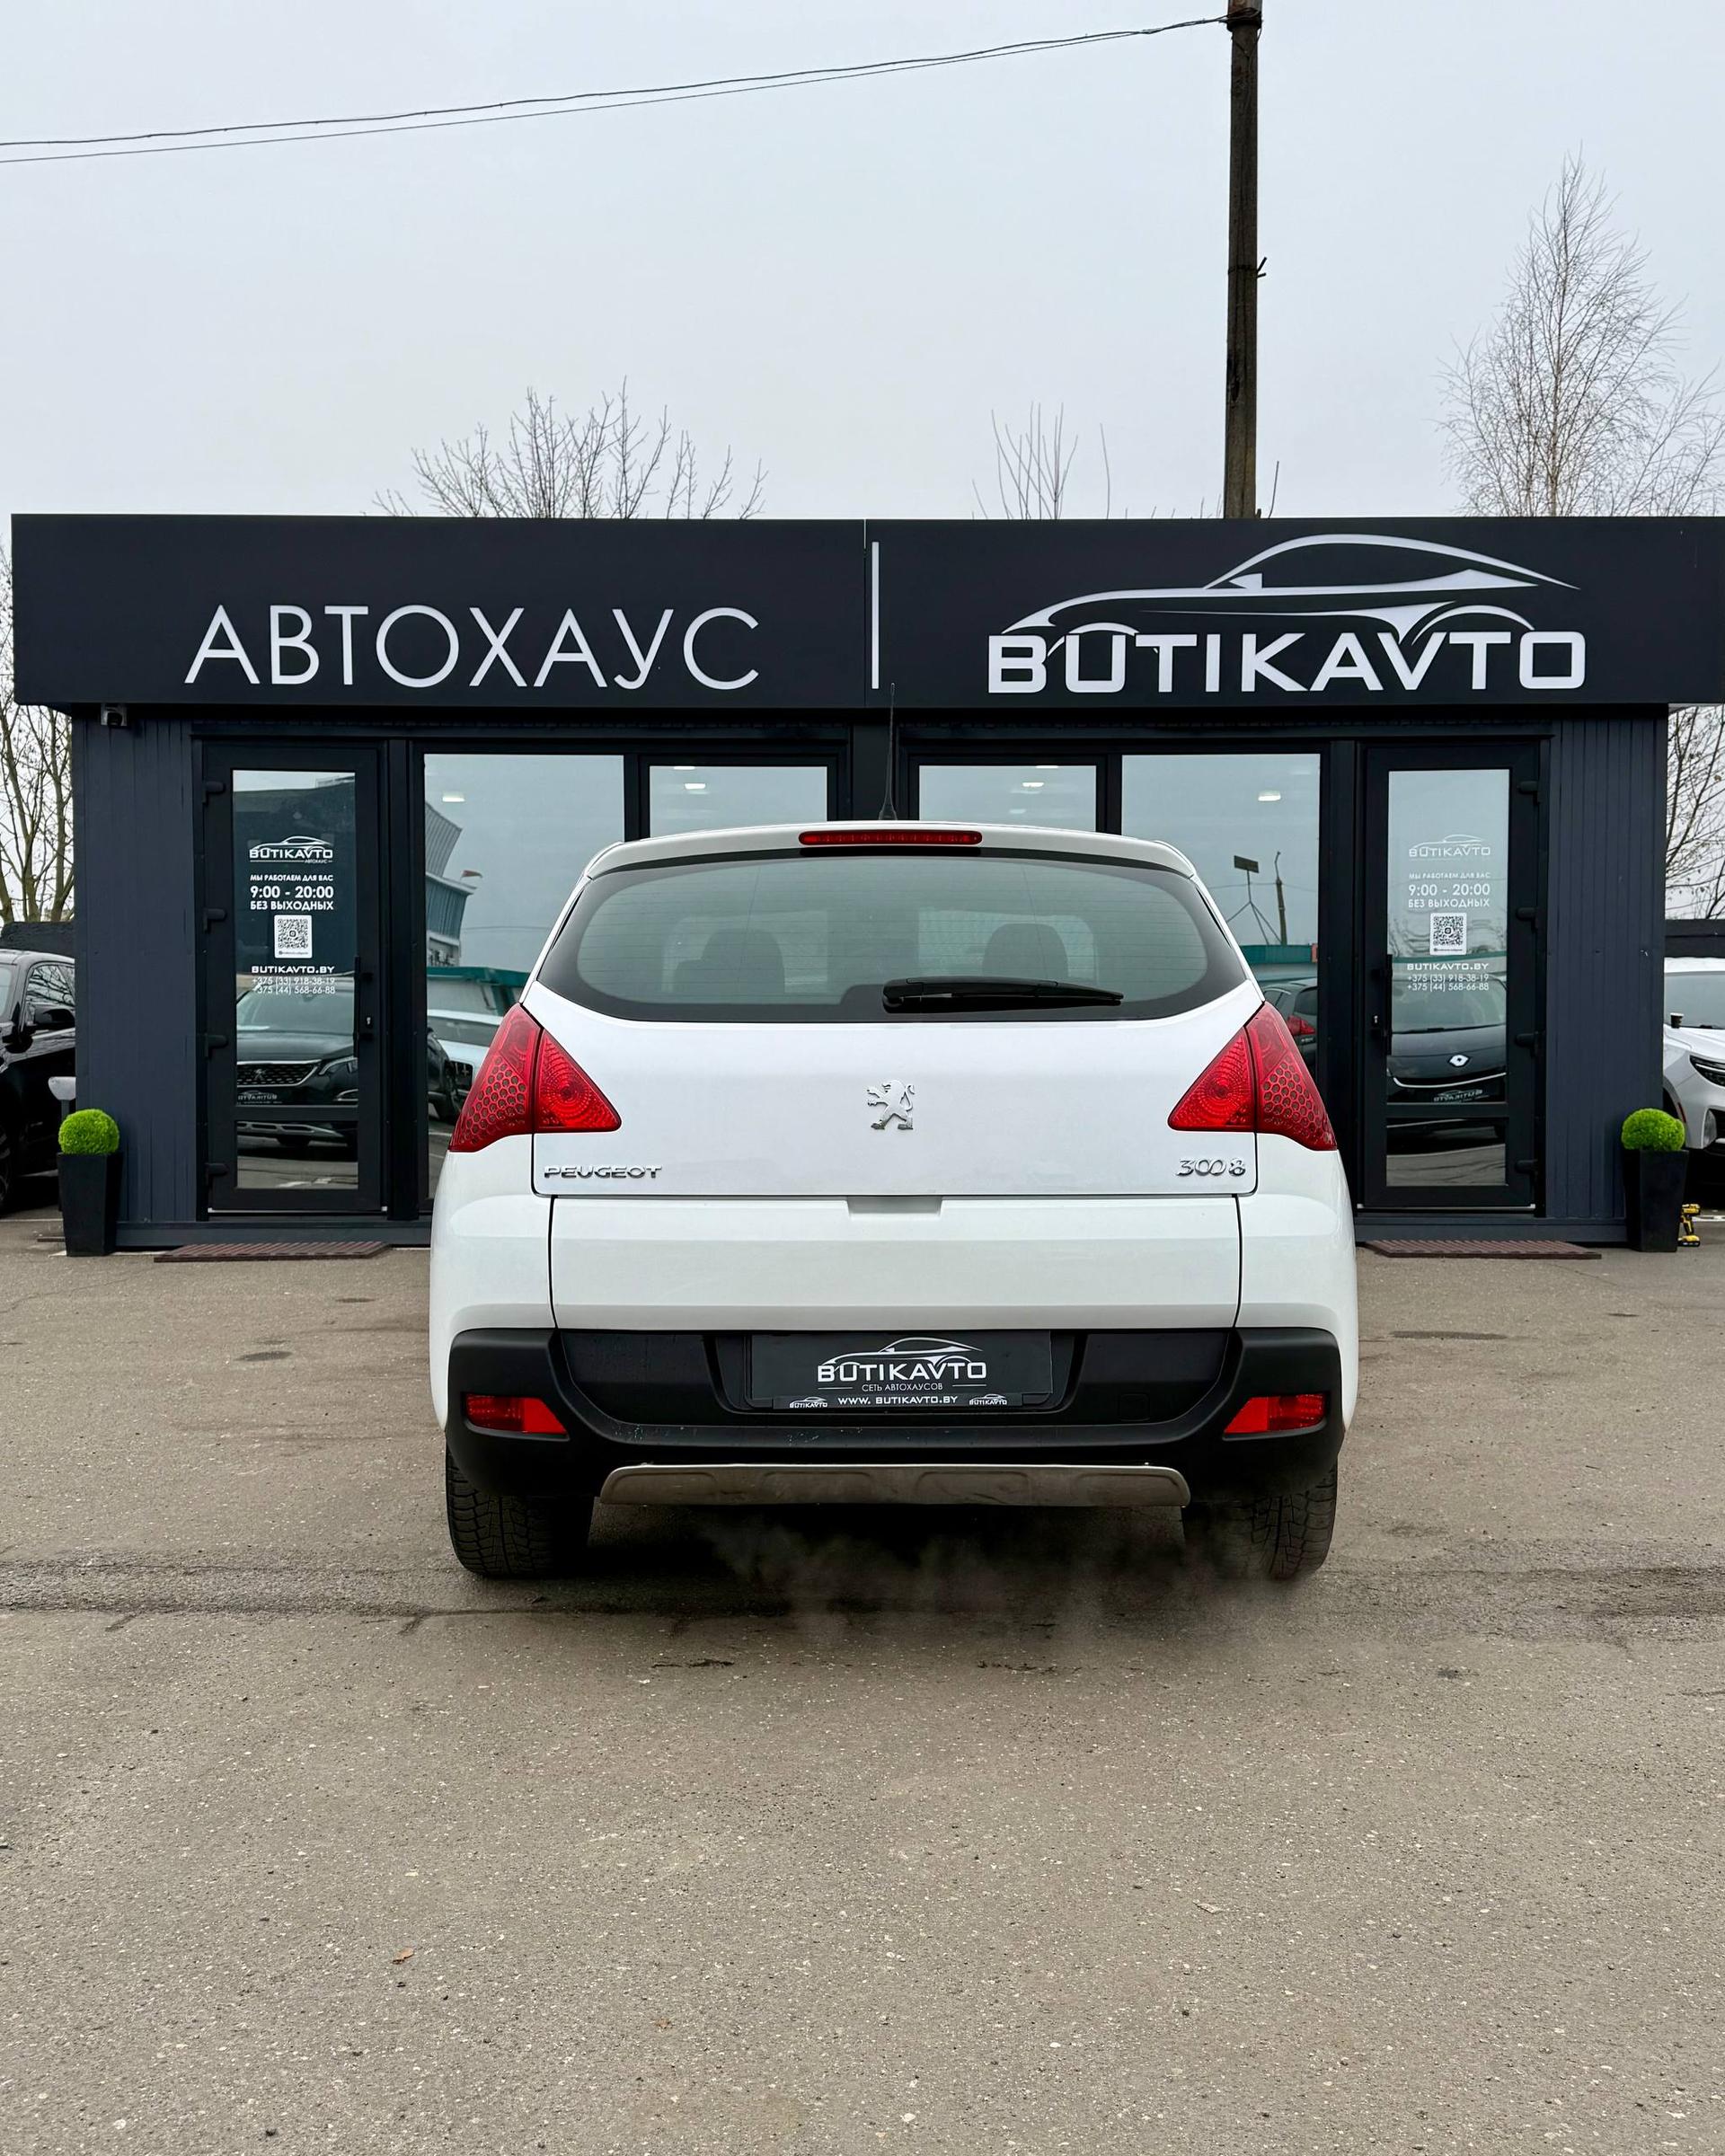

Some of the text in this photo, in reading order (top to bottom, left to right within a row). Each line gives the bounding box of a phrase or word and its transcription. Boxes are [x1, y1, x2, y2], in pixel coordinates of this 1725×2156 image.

[184, 604, 759, 690] АВТОХАУС
[988, 631, 1587, 694] BUTIKAVTO
[249, 849, 333, 859] BUTIKAVTO
[1408, 846, 1491, 857] BUTIKAVTO
[250, 886, 280, 898] 9:00
[295, 886, 334, 898] 20:00
[1408, 884, 1438, 897] 9:00
[1452, 883, 1491, 896] 20:00
[250, 900, 334, 911] БЕЗ ВЫХОДНЫХ
[1408, 898, 1490, 908] БЕЗ ВЫХОДНЫХ
[251, 966, 335, 974] BUTIKAVTO.BY
[1407, 963, 1490, 971] BUTIKAVTO.BY
[252, 976, 335, 986] +375 (33) 918-38-19
[1408, 973, 1489, 984] +375 (33) 918-38-19
[252, 985, 335, 995] +375 (44) 568-66-88
[1408, 983, 1489, 992] +375 (44) 568-66-88
[544, 1165, 662, 1179] PEUGEOT
[1175, 1158, 1246, 1177] 3008
[818, 1362, 986, 1383] BUTIKAVTO
[862, 1383, 942, 1392] СЕТЬ АВТОХАУСОВ
